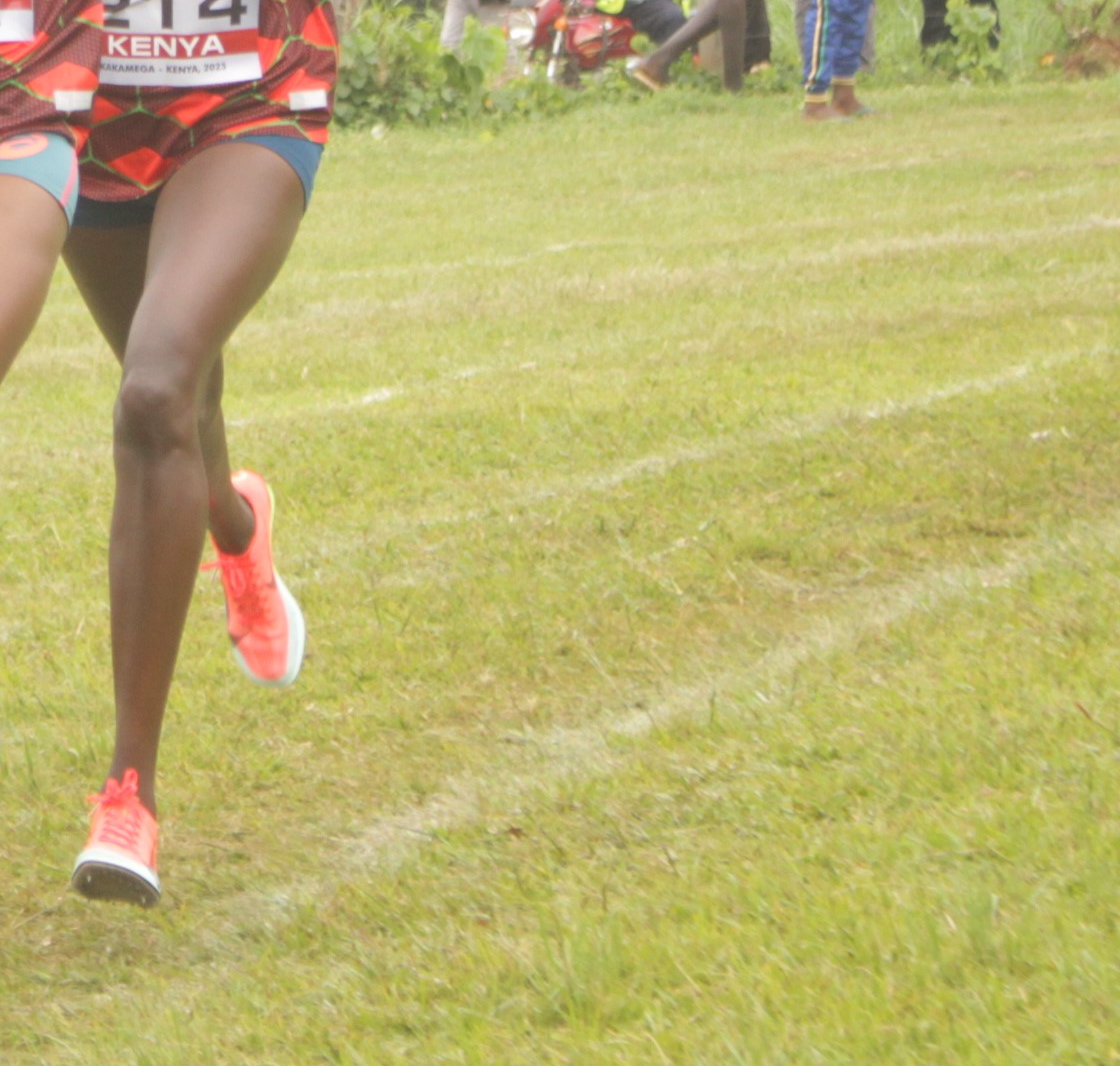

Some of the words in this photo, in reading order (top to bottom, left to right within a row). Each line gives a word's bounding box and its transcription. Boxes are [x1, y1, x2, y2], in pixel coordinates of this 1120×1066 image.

[107, 33, 225, 57] KENYA
[166, 65, 200, 74] KENYA,
[203, 62, 227, 72] 2025
